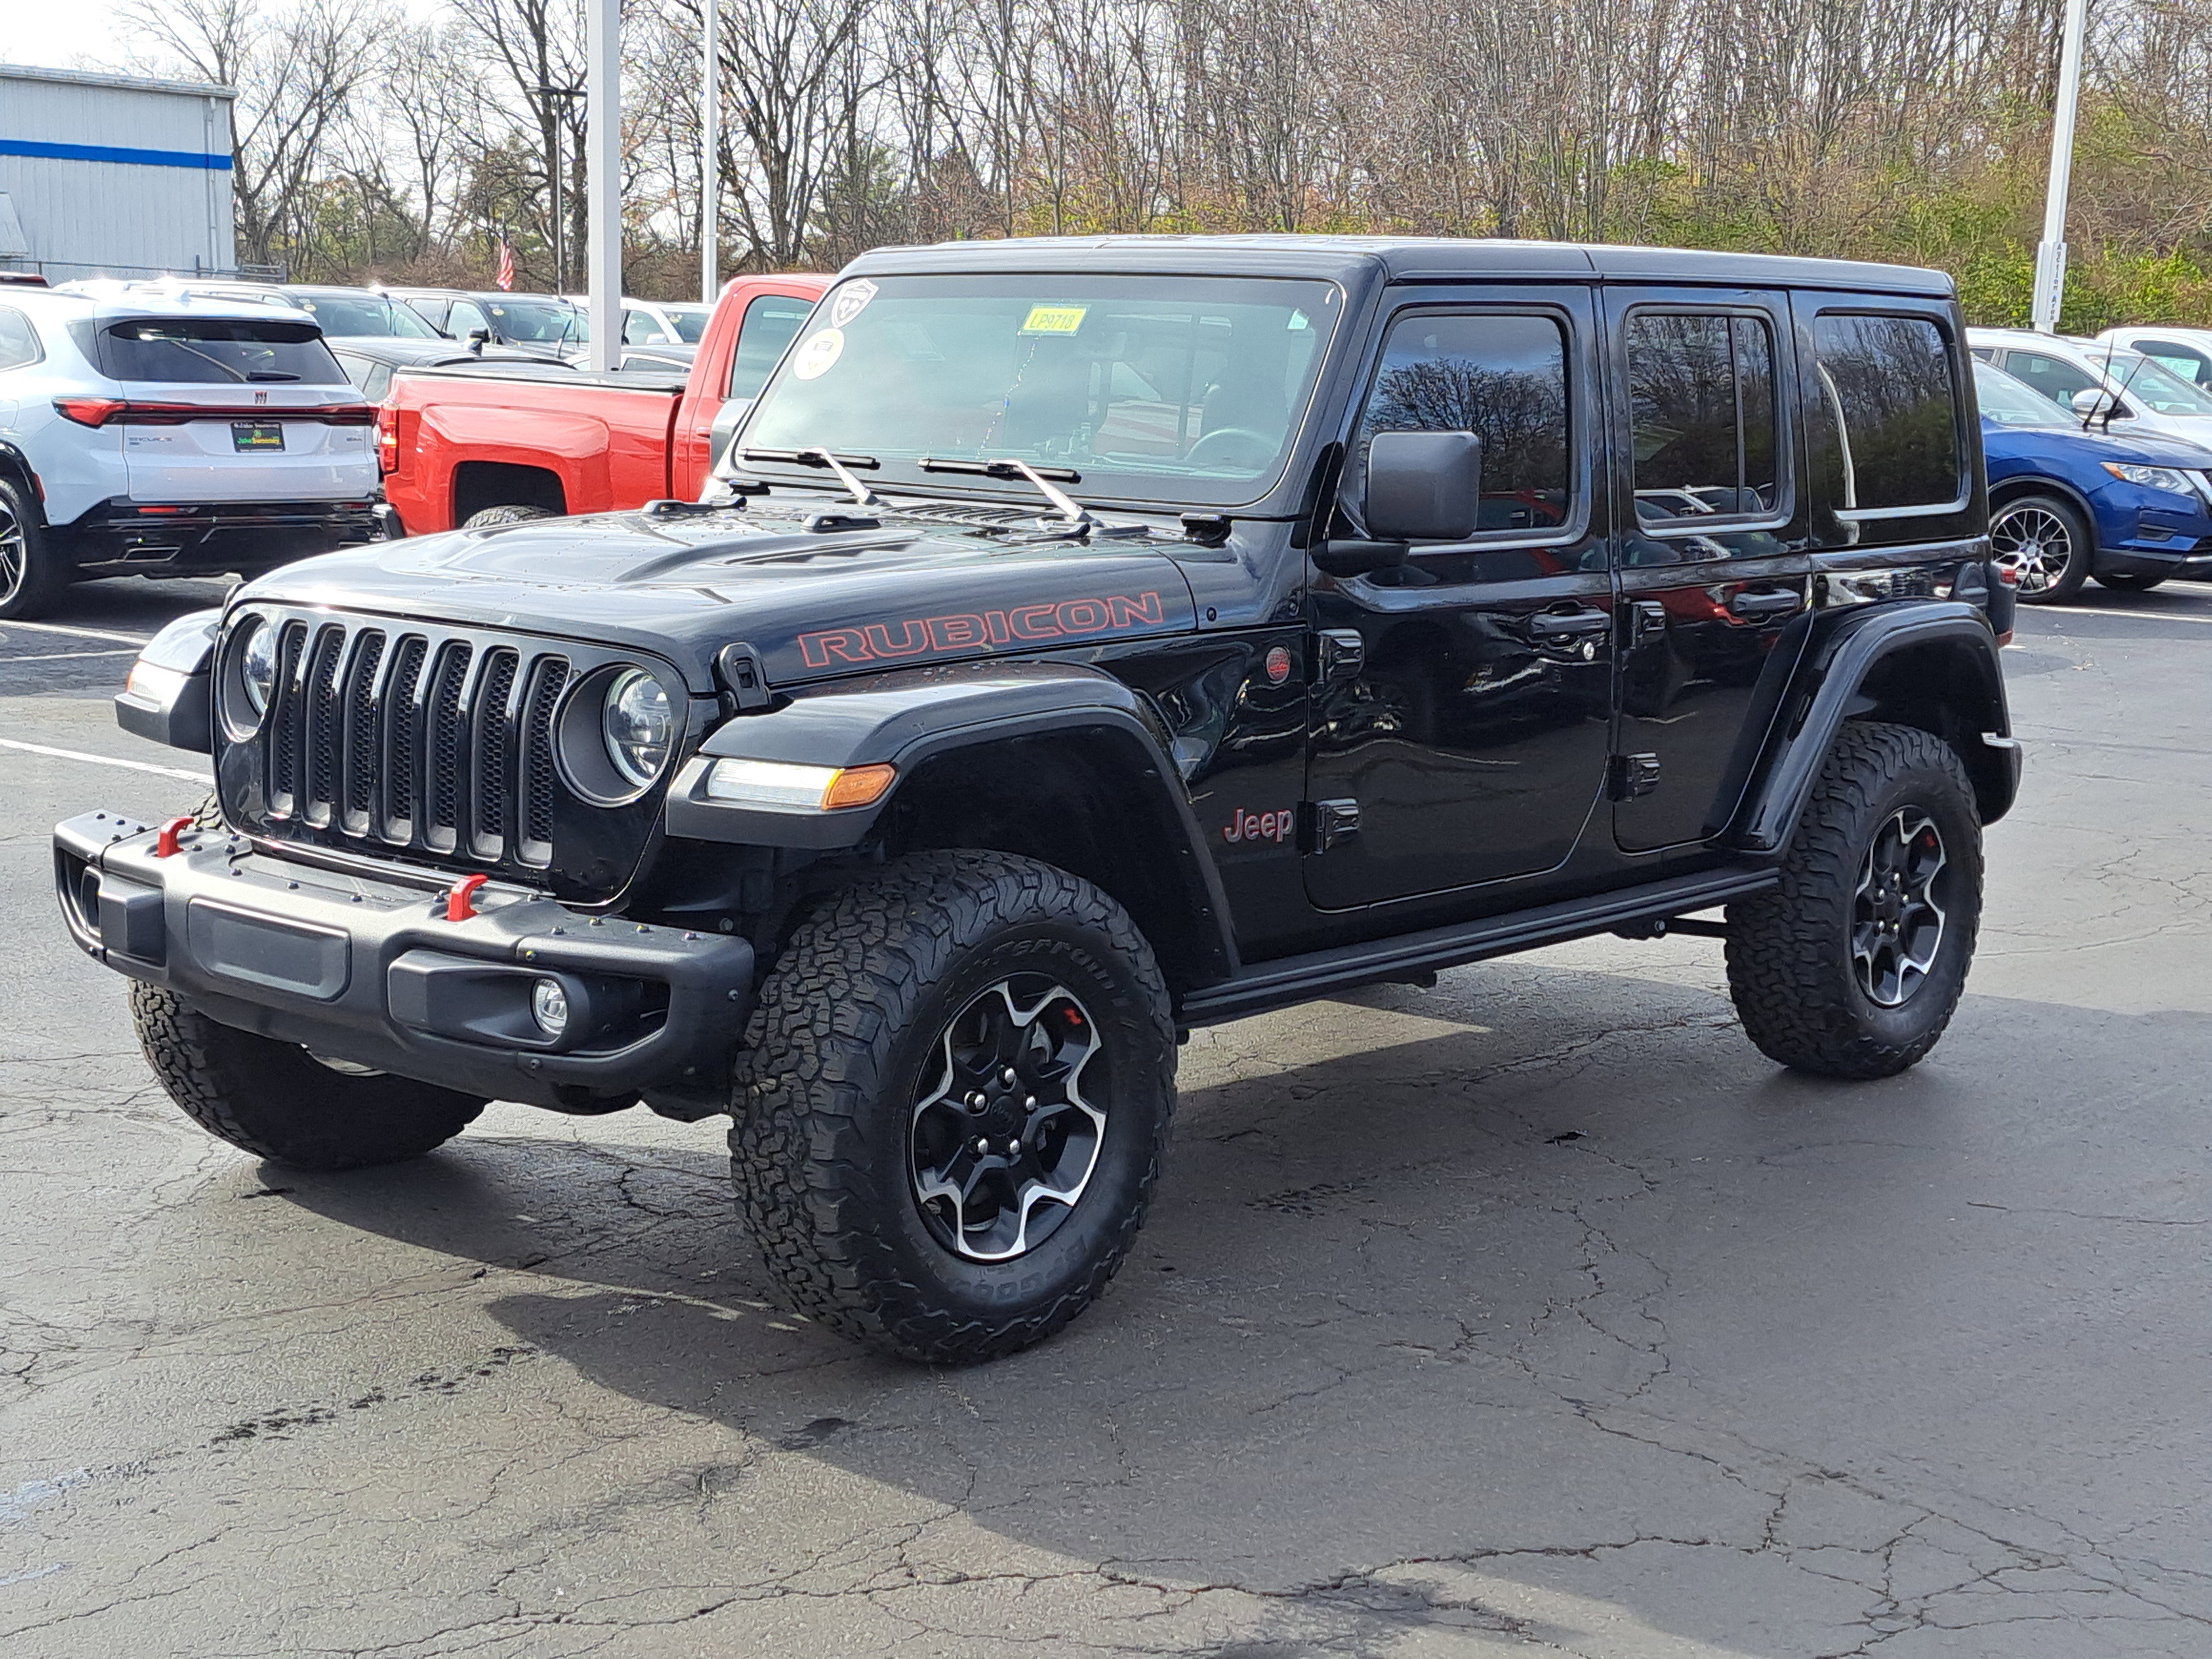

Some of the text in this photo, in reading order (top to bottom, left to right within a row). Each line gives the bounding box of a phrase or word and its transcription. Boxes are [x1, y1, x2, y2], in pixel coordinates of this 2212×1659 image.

[1029, 313, 1075, 329] LP9718
[797, 592, 1164, 667] RUBICON
[1223, 807, 1294, 843] Jeep
